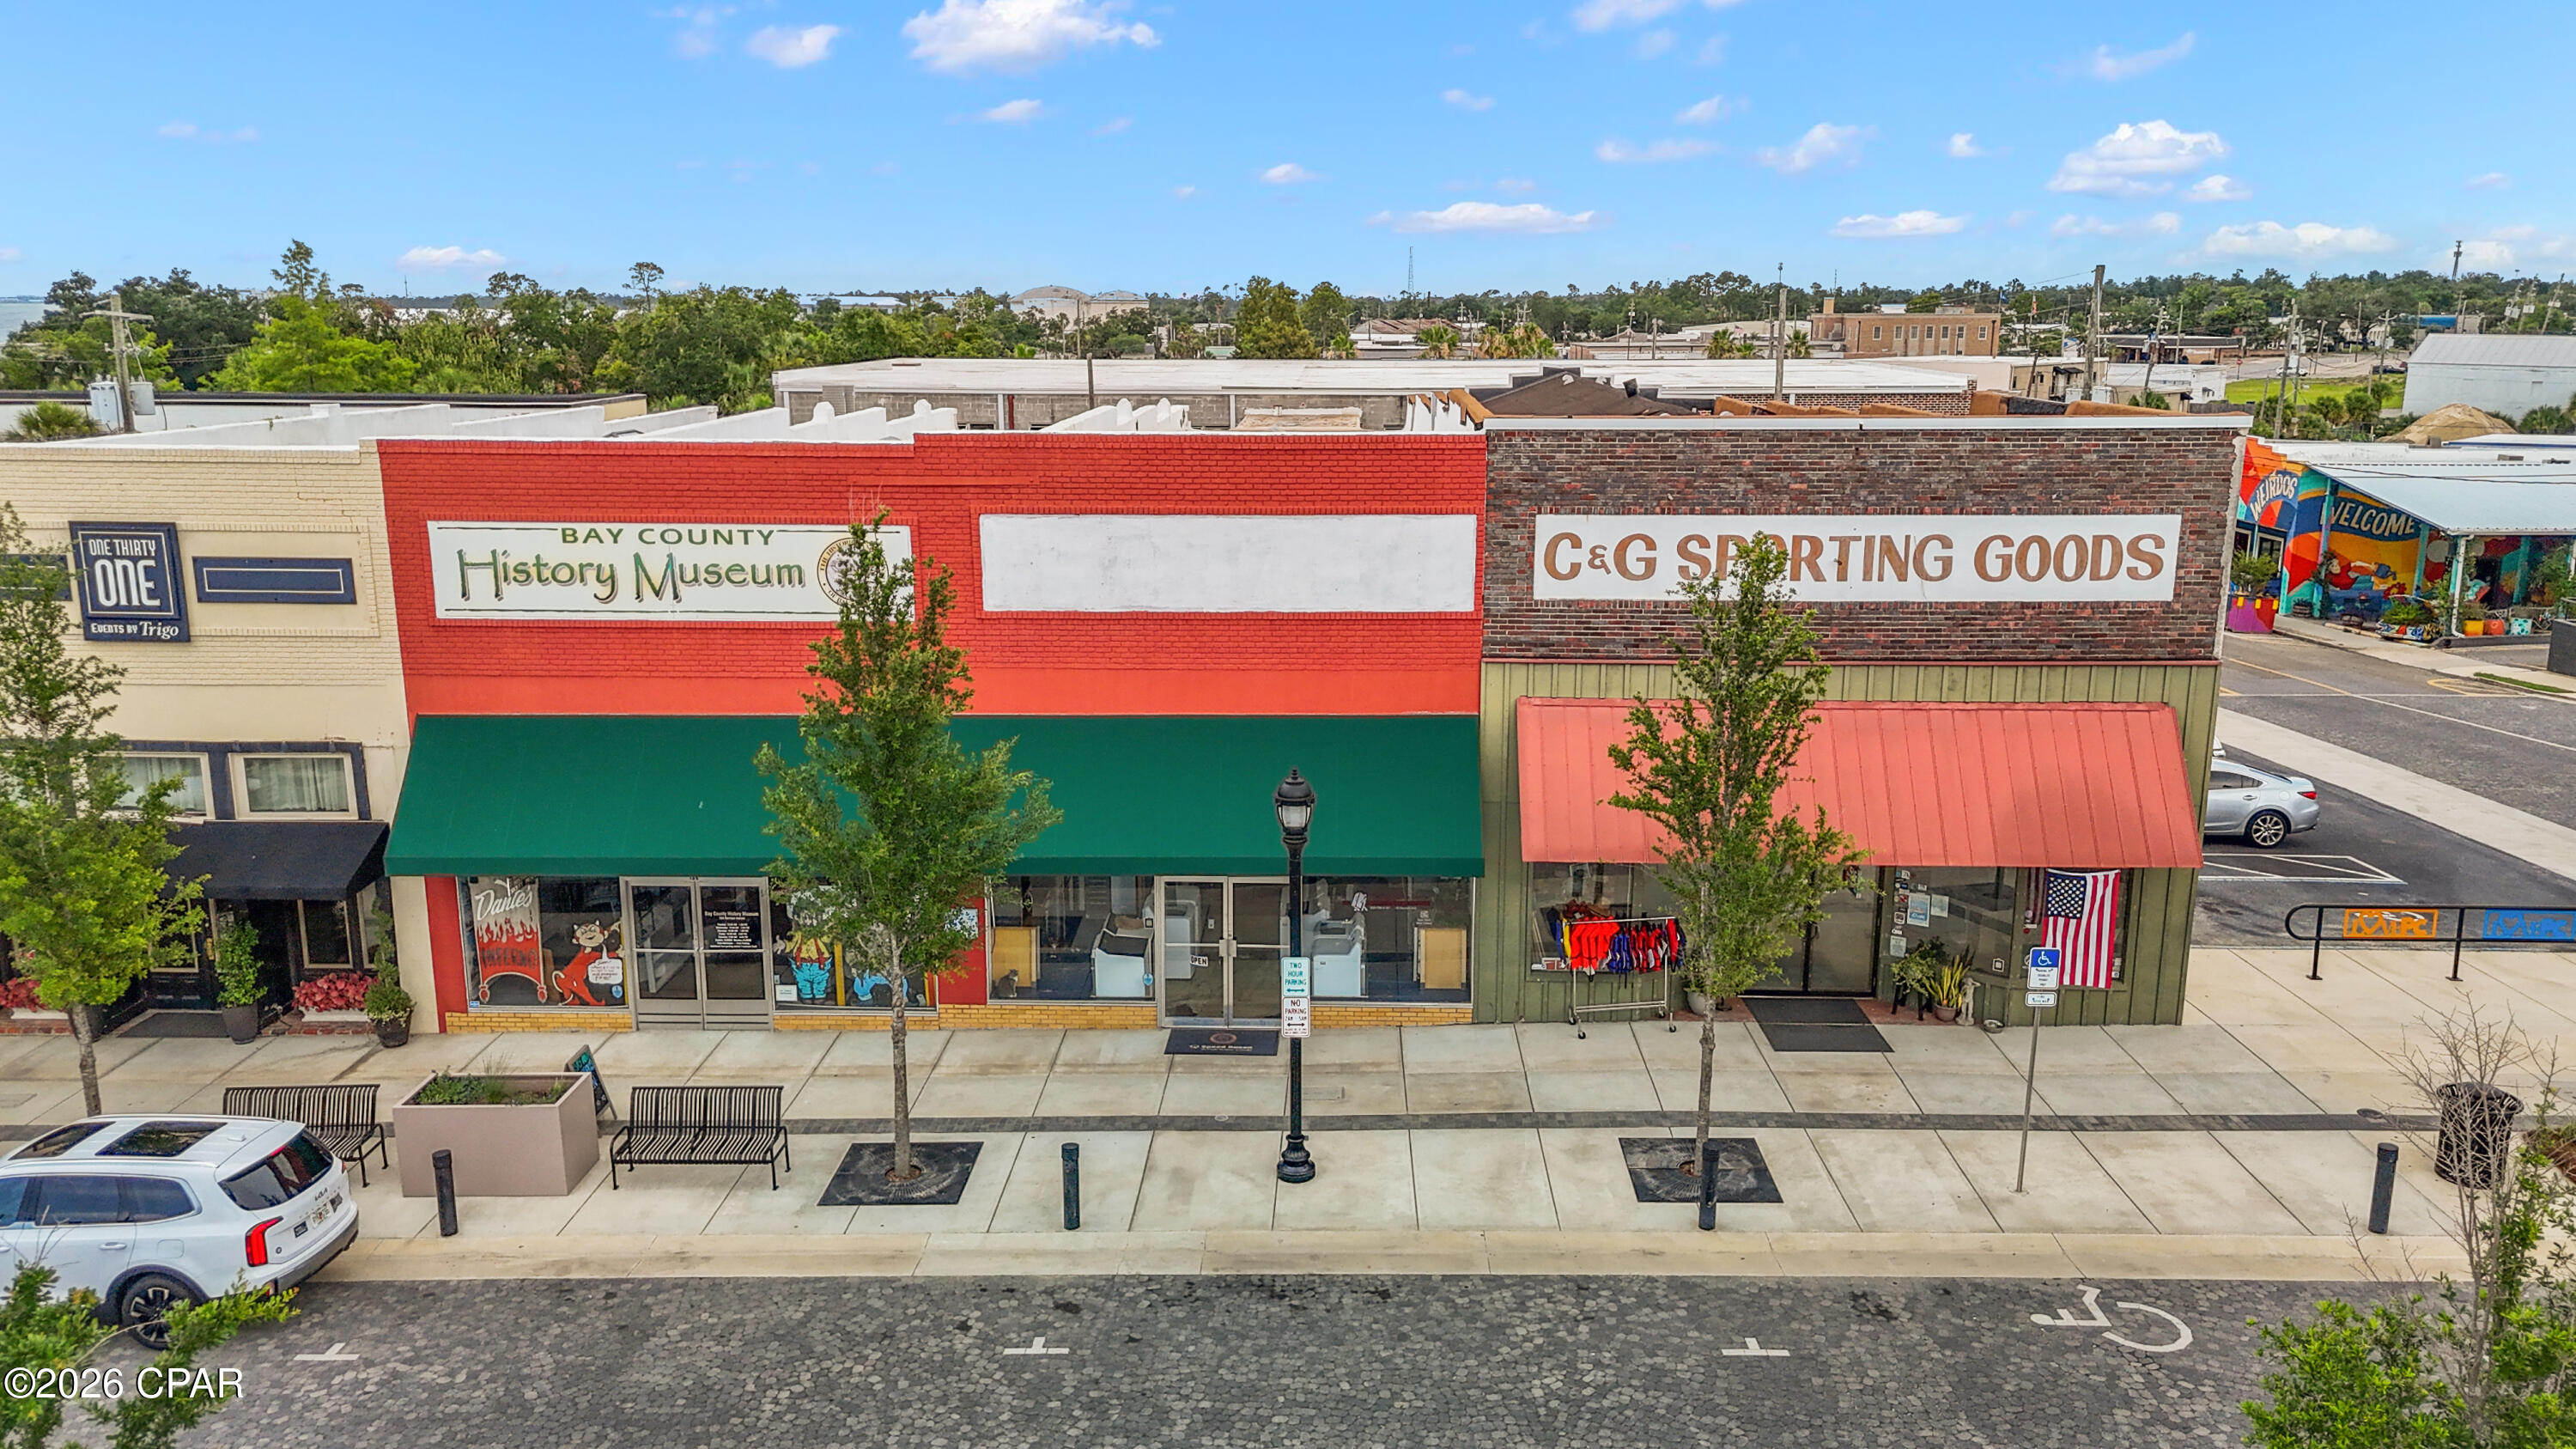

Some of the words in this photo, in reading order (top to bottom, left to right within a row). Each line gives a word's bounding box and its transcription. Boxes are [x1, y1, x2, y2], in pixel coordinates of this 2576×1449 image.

[2251, 473, 2298, 521] WEIRDOS
[560, 527, 624, 545] BAY
[637, 528, 775, 545] COUNTY
[2320, 501, 2417, 537] WELCOME
[88, 539, 112, 556] ONE
[112, 539, 156, 557] THIRTY
[1544, 532, 1657, 581] C&G
[1973, 533, 2166, 582] GOODS
[94, 558, 161, 607] ONE
[457, 548, 619, 604] History
[633, 551, 806, 604] Museum
[126, 624, 137, 634] BY
[139, 621, 179, 640] Trigo
[474, 878, 532, 921] Dante's
[1190, 955, 1207, 965] OPEN
[1291, 999, 1301, 1008] NO
